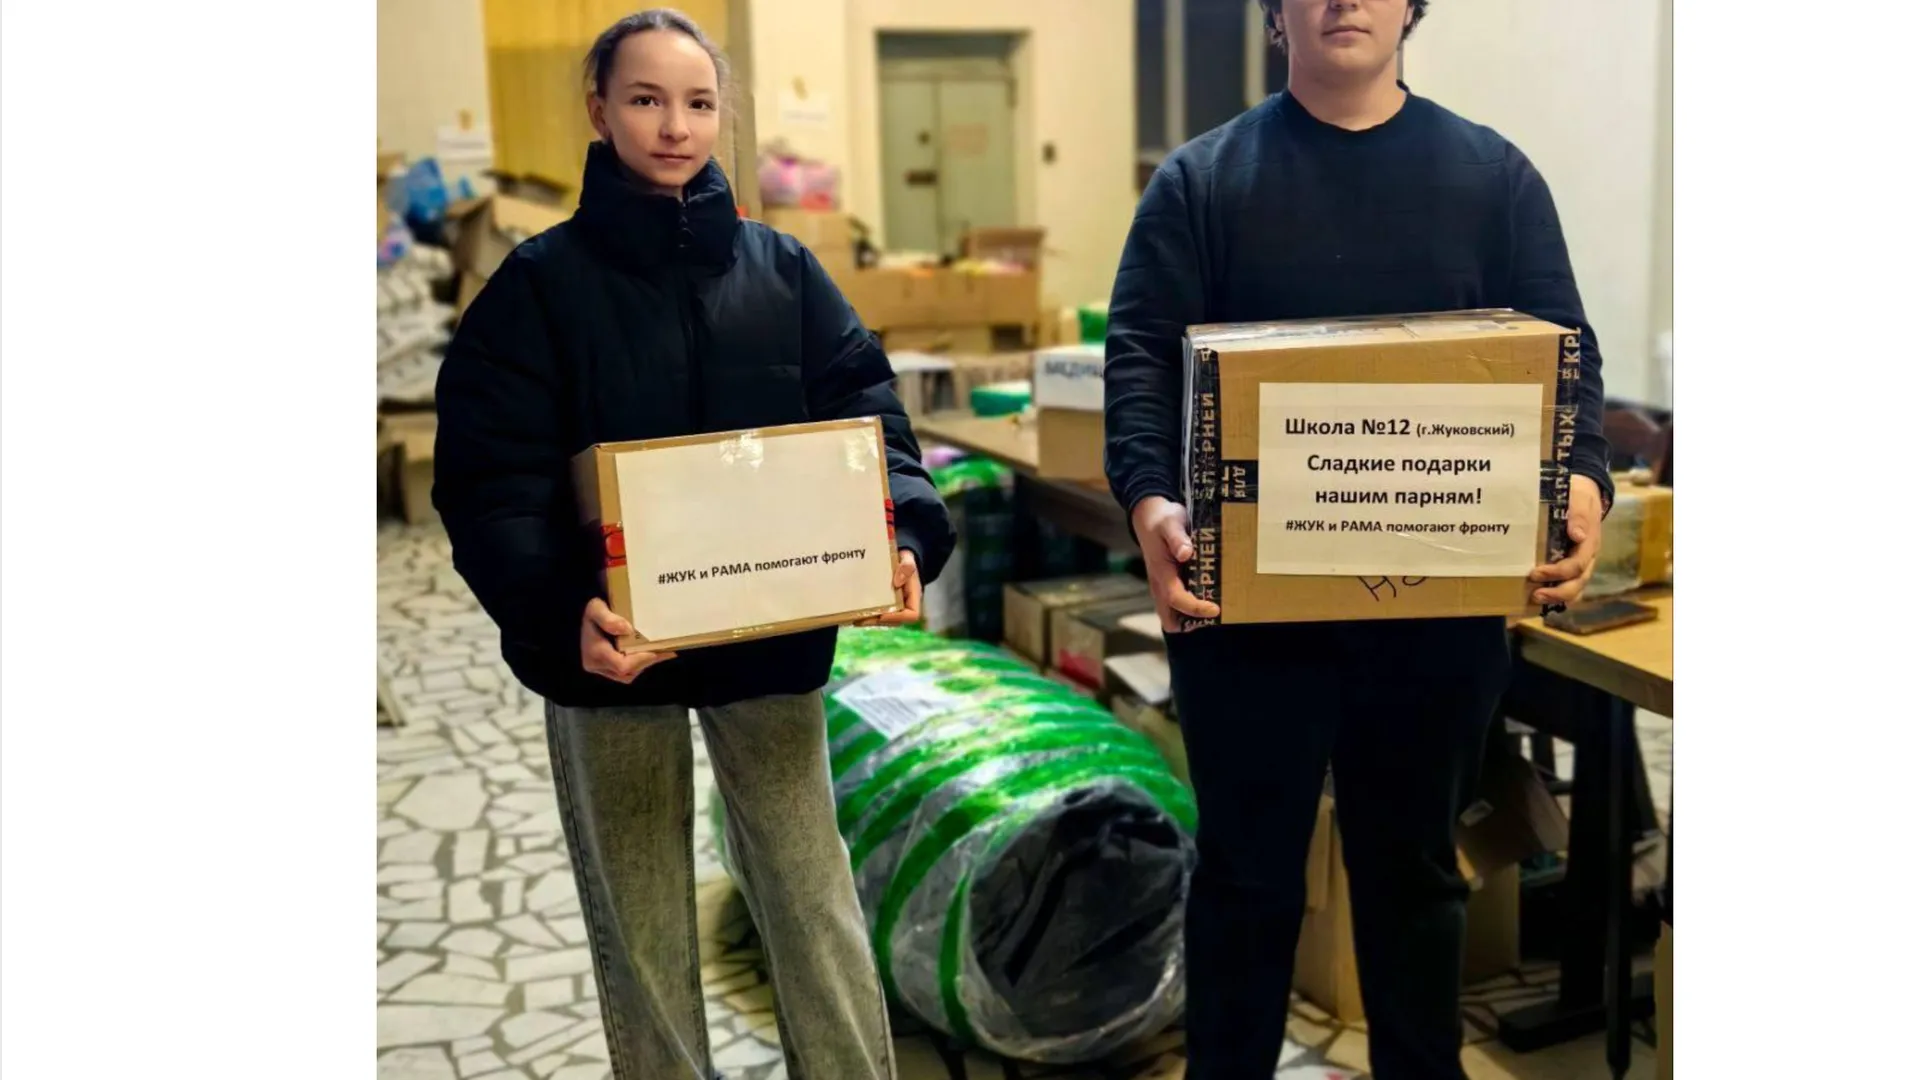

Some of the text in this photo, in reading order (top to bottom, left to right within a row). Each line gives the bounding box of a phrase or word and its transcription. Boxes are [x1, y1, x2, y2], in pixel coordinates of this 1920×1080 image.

[1285, 418, 1515, 438] Школа №12 (г.Жуковский)
[1307, 454, 1491, 476] Сладкие подарки
[1315, 487, 1482, 508] нашим парням!
[1285, 519, 1510, 535] #ЖУК и РАМА помогают фронту
[658, 549, 866, 584] #ЖУК и РАМА помогают фронту
